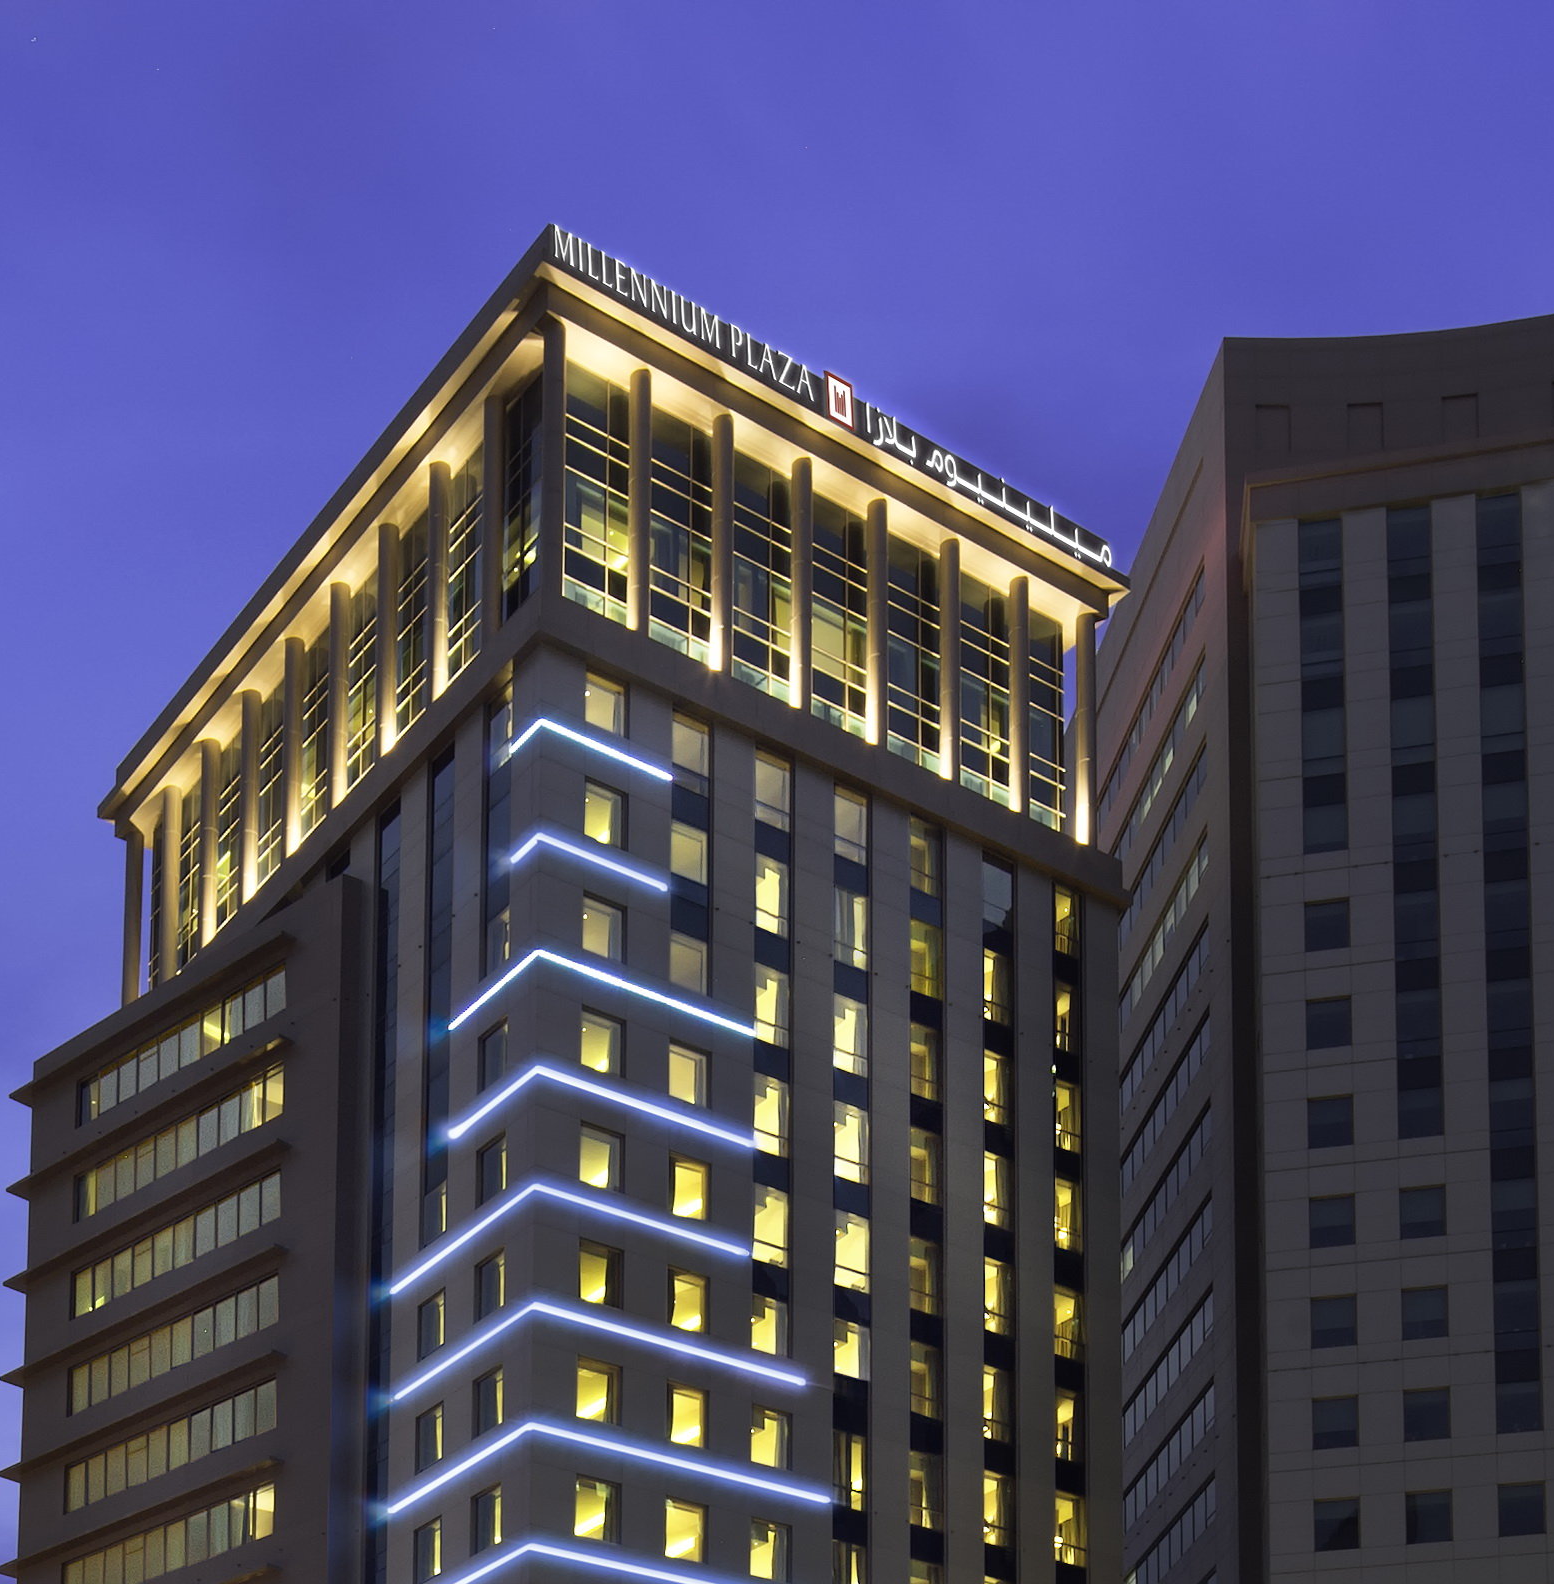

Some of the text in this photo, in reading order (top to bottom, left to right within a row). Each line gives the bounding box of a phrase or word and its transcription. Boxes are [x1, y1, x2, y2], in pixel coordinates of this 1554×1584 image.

[553, 223, 815, 402] MILLENNIUM PLAZA
[865, 401, 1113, 568] ميلينيوم بلازا
